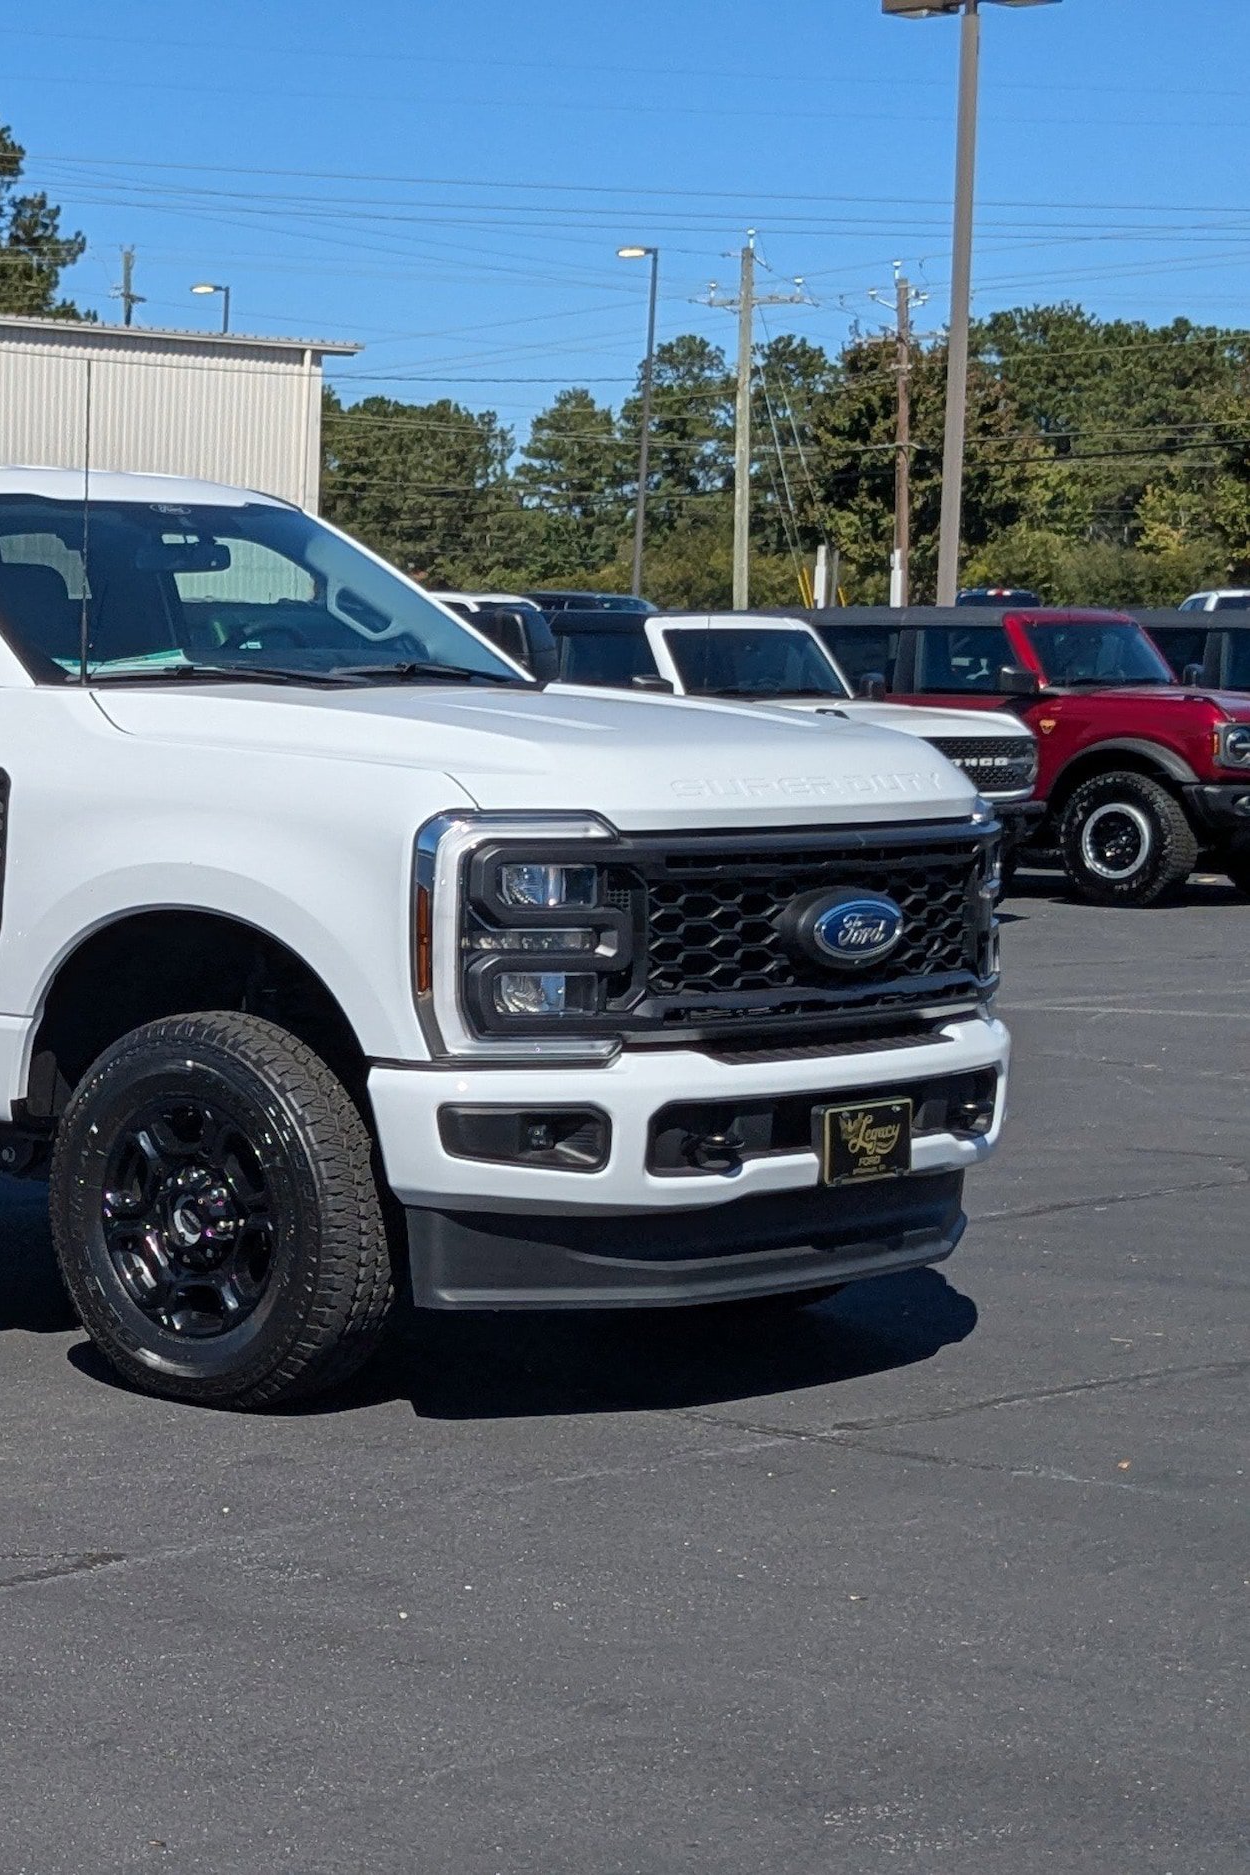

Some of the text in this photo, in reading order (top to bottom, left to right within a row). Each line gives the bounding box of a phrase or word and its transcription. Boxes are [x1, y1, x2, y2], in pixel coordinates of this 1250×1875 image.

[670, 771, 942, 798] SUPER DUTY
[837, 913, 886, 947] Ford
[848, 1114, 901, 1155] Legacy
